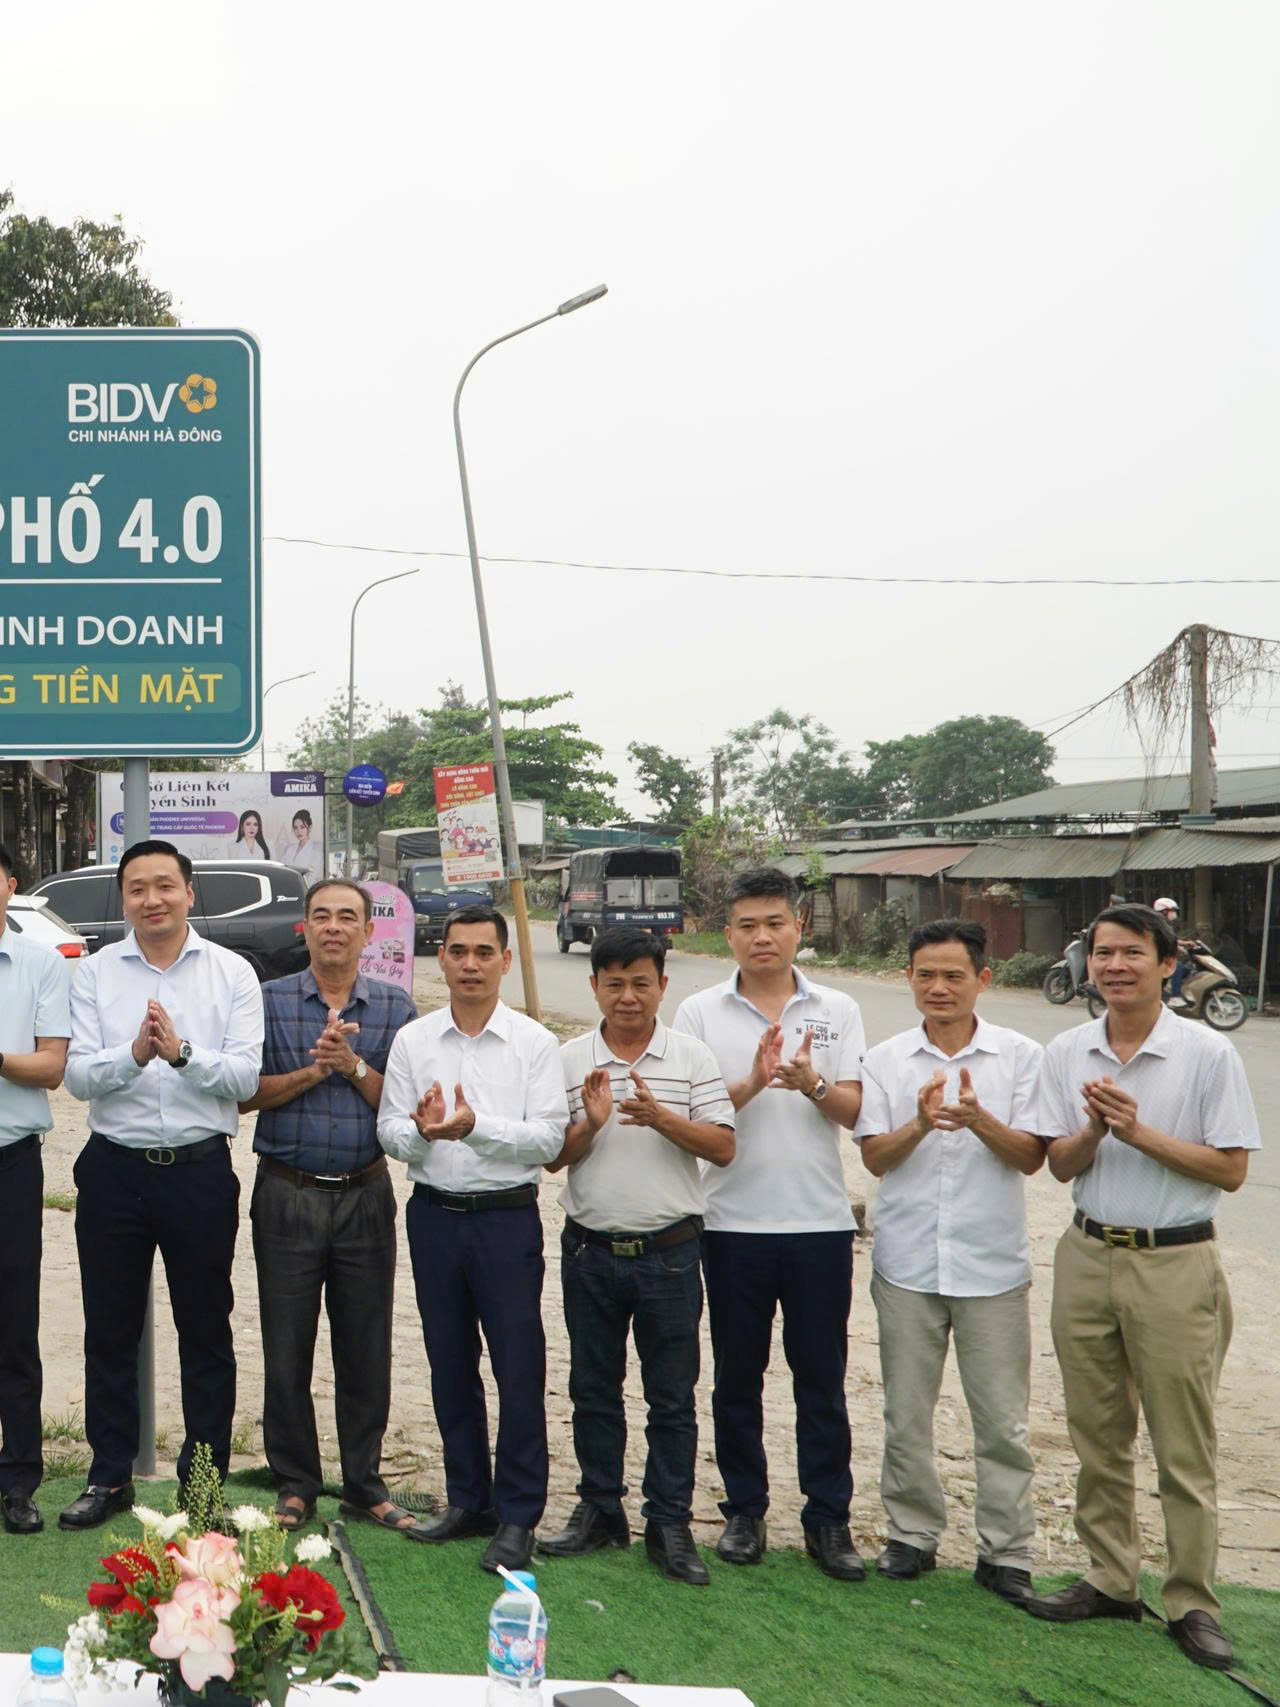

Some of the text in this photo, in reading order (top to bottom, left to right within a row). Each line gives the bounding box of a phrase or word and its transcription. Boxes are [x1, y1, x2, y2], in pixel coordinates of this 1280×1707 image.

[68, 383, 180, 423] BIDV
[68, 427, 222, 442] CHI NHÁNH HÀ ĐÔNG
[118, 496, 222, 563] 4.0
[78, 616, 223, 645] DOANH
[33, 666, 119, 703] TIỀN
[140, 667, 223, 711] MẶT
[168, 780, 201, 792] Liên
[207, 779, 230, 792] Kết
[284, 783, 317, 793] AMIKA
[151, 795, 216, 809] yển Sinh
[372, 906, 395, 918] IKA
